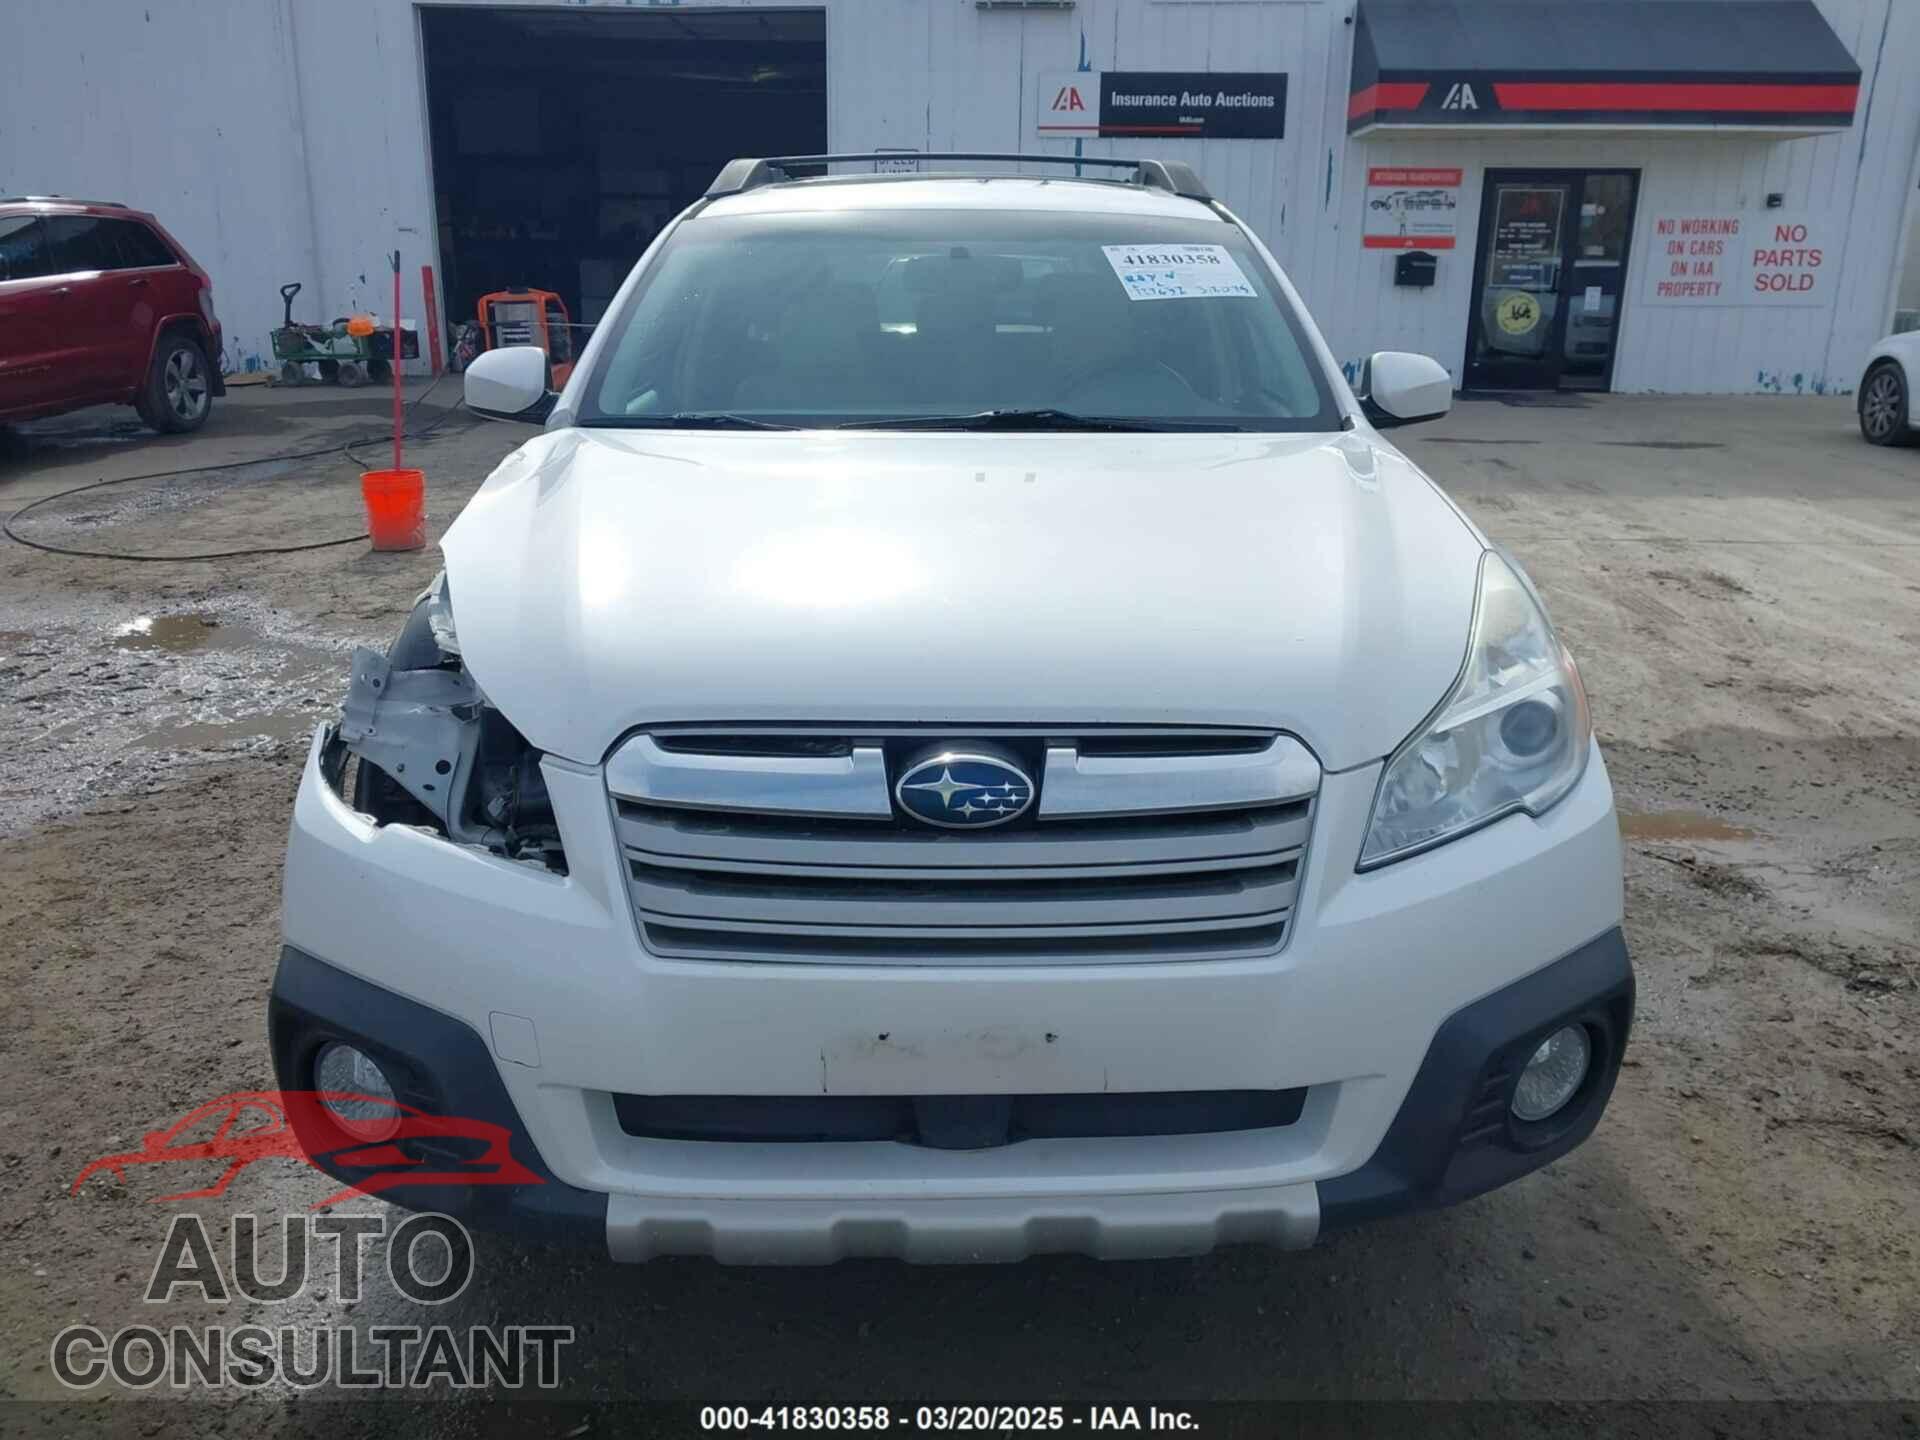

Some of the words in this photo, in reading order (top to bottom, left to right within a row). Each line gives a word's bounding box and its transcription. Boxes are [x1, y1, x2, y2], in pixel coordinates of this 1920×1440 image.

[1111, 91, 1177, 107] Insurance
[1180, 91, 1212, 107] Auto
[1215, 91, 1275, 108] Auctions
[1657, 219, 1674, 235] NO
[1681, 219, 1740, 235] WORKING
[1775, 224, 1808, 243] NO
[1667, 240, 1684, 256] ON
[1690, 240, 1724, 256] CARS
[1122, 253, 1221, 265] 41830358
[1753, 249, 1823, 268] PARTS
[1670, 261, 1687, 277] ON
[1693, 261, 1714, 277] IAA
[1657, 281, 1722, 297] PROPERTY
[1754, 273, 1815, 292] SOLD
